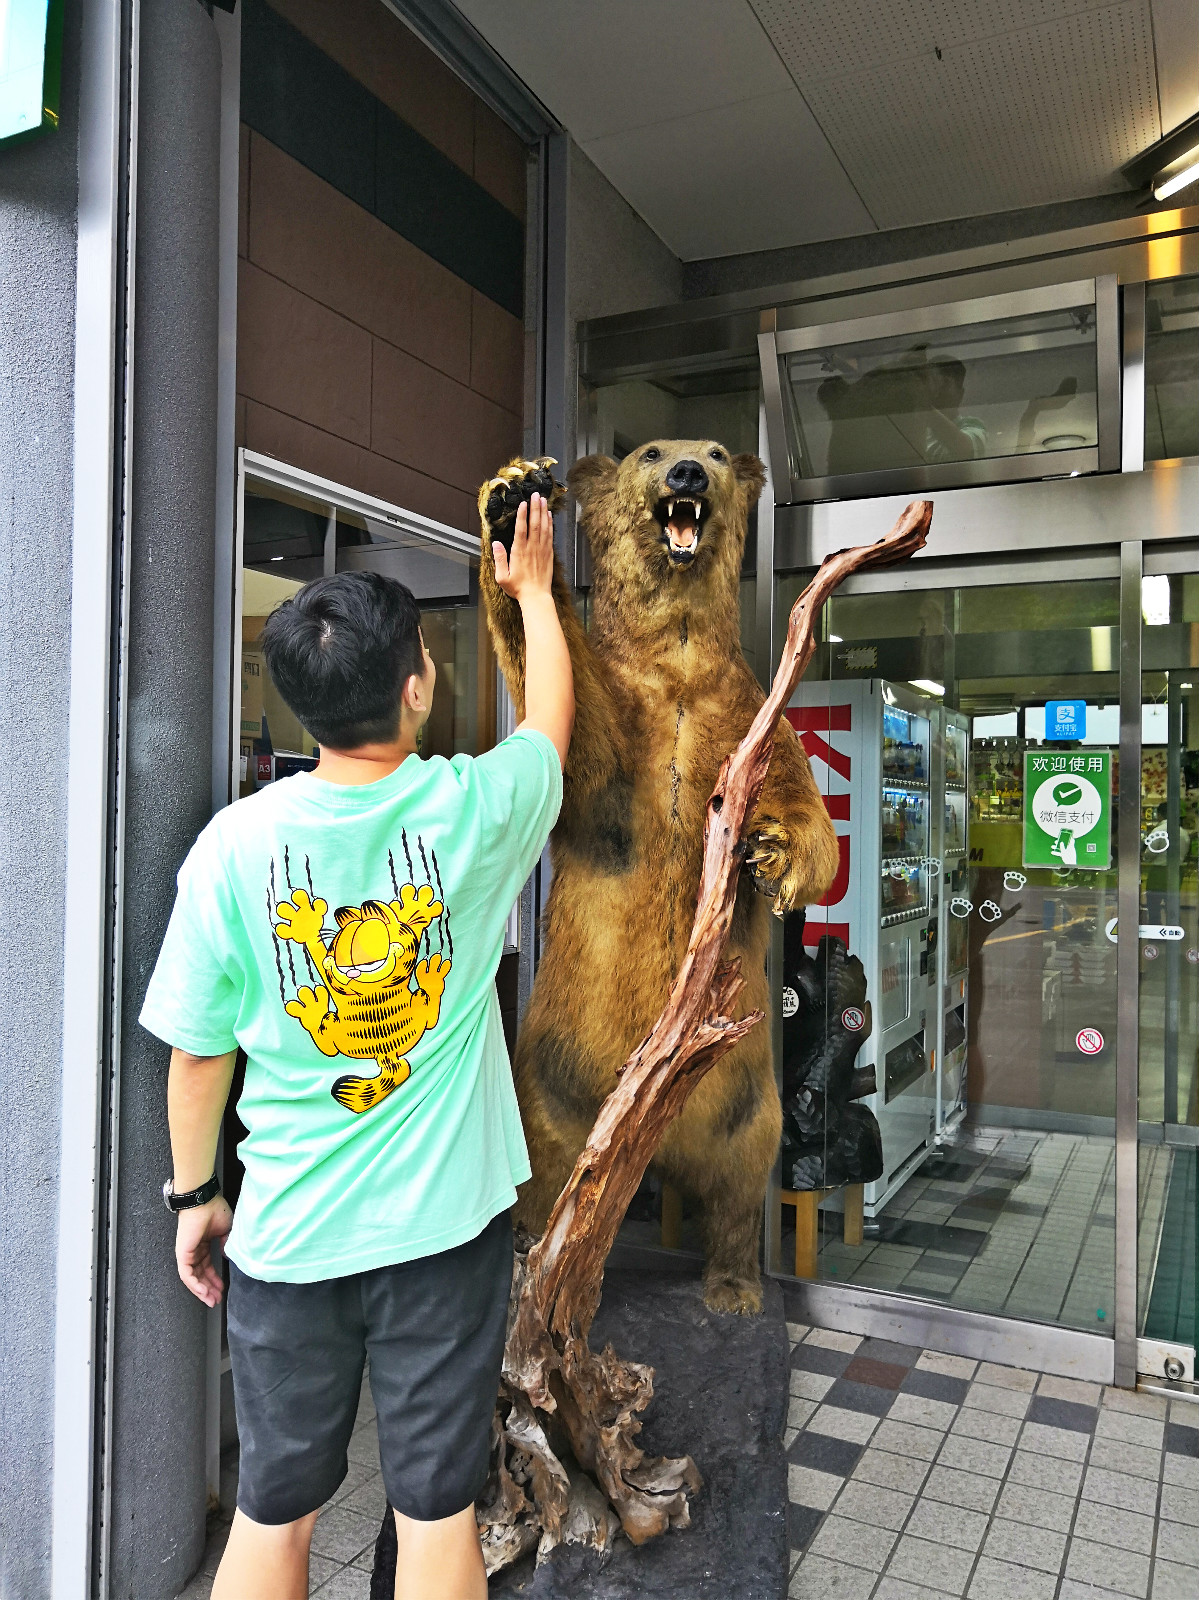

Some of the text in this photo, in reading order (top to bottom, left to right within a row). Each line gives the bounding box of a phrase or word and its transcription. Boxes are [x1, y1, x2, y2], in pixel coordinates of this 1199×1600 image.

[258, 764, 270, 773] A3
[1032, 756, 1103, 773] 欢迎使用
[1039, 810, 1094, 824] 微信支付
